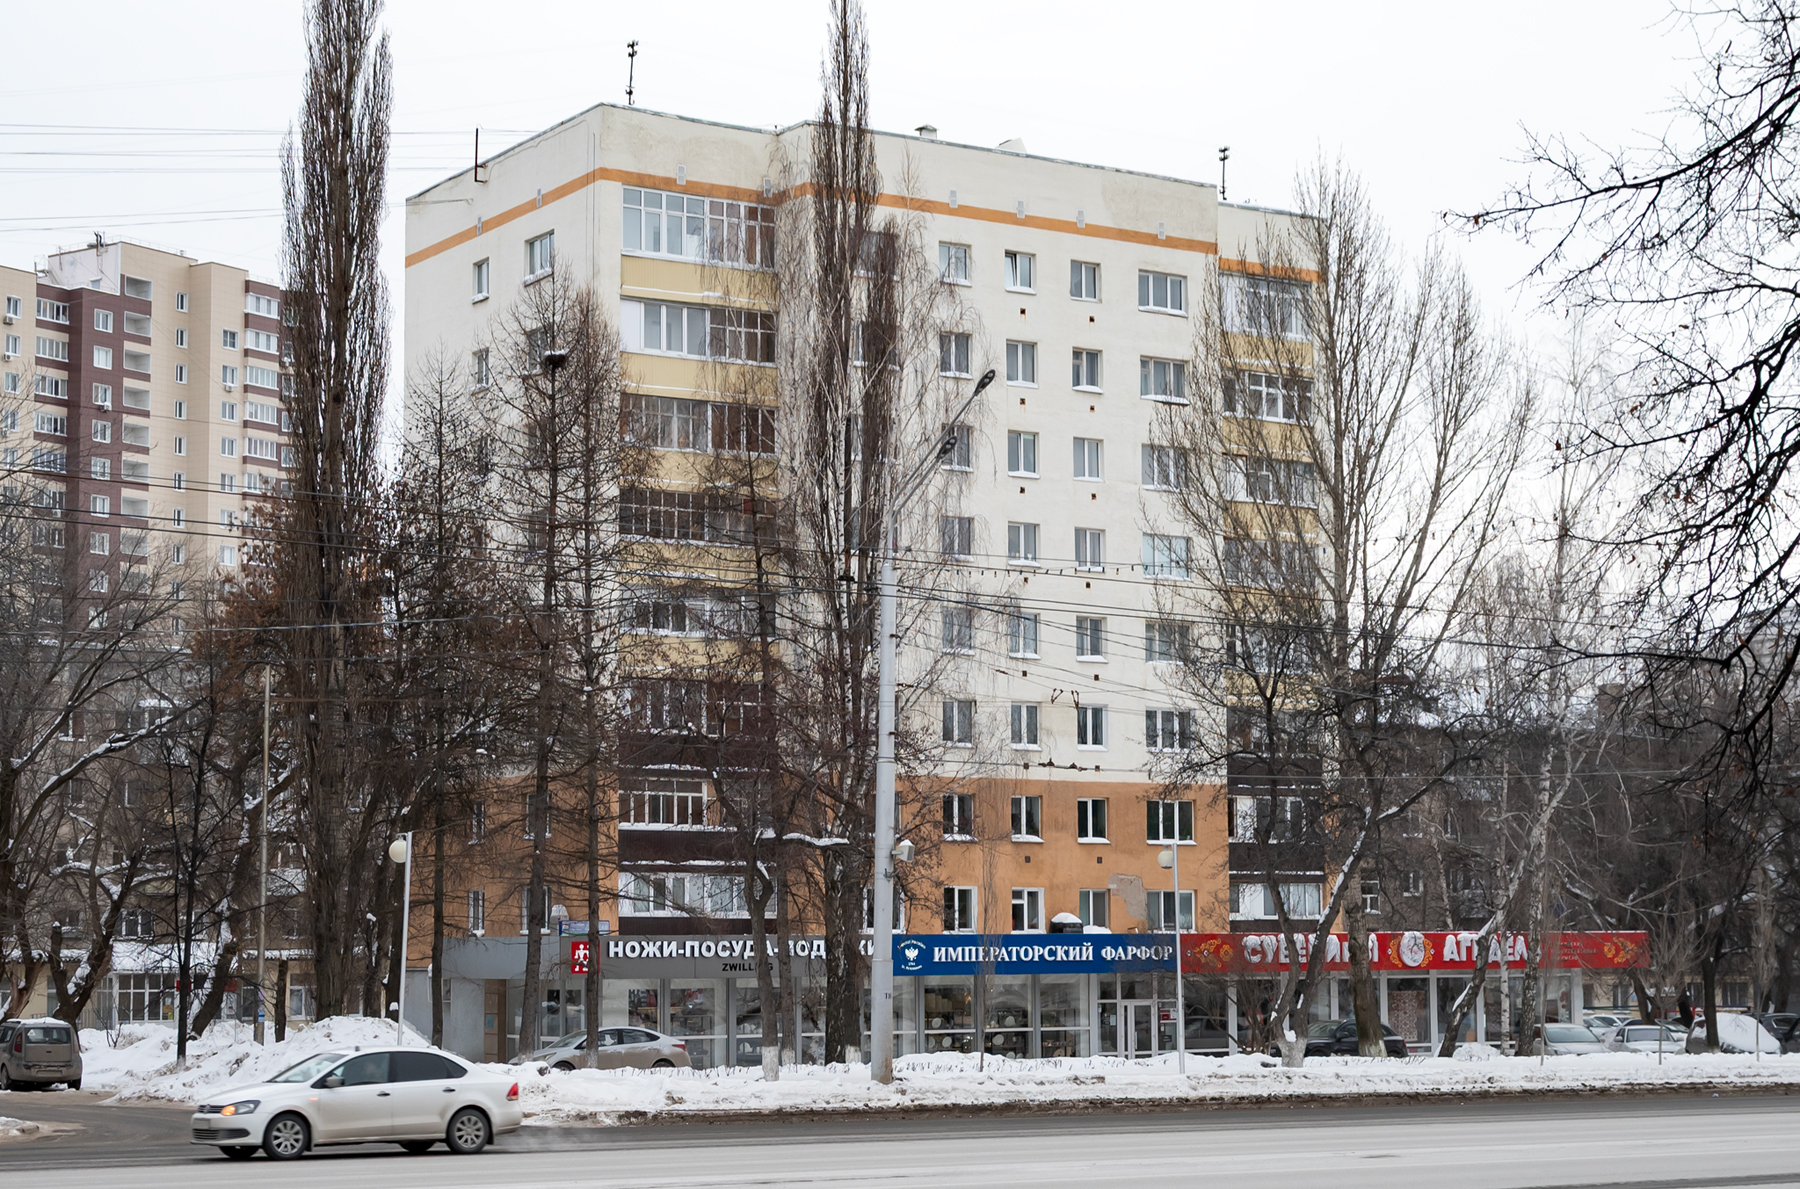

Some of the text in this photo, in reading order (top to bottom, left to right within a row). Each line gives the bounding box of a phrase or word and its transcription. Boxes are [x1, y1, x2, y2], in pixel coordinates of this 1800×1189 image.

[933, 942, 1094, 963] ИМПЕРАТОРСКИЙ
[1100, 945, 1173, 962] ФАРФОР
[721, 963, 774, 972] ZWILLG
